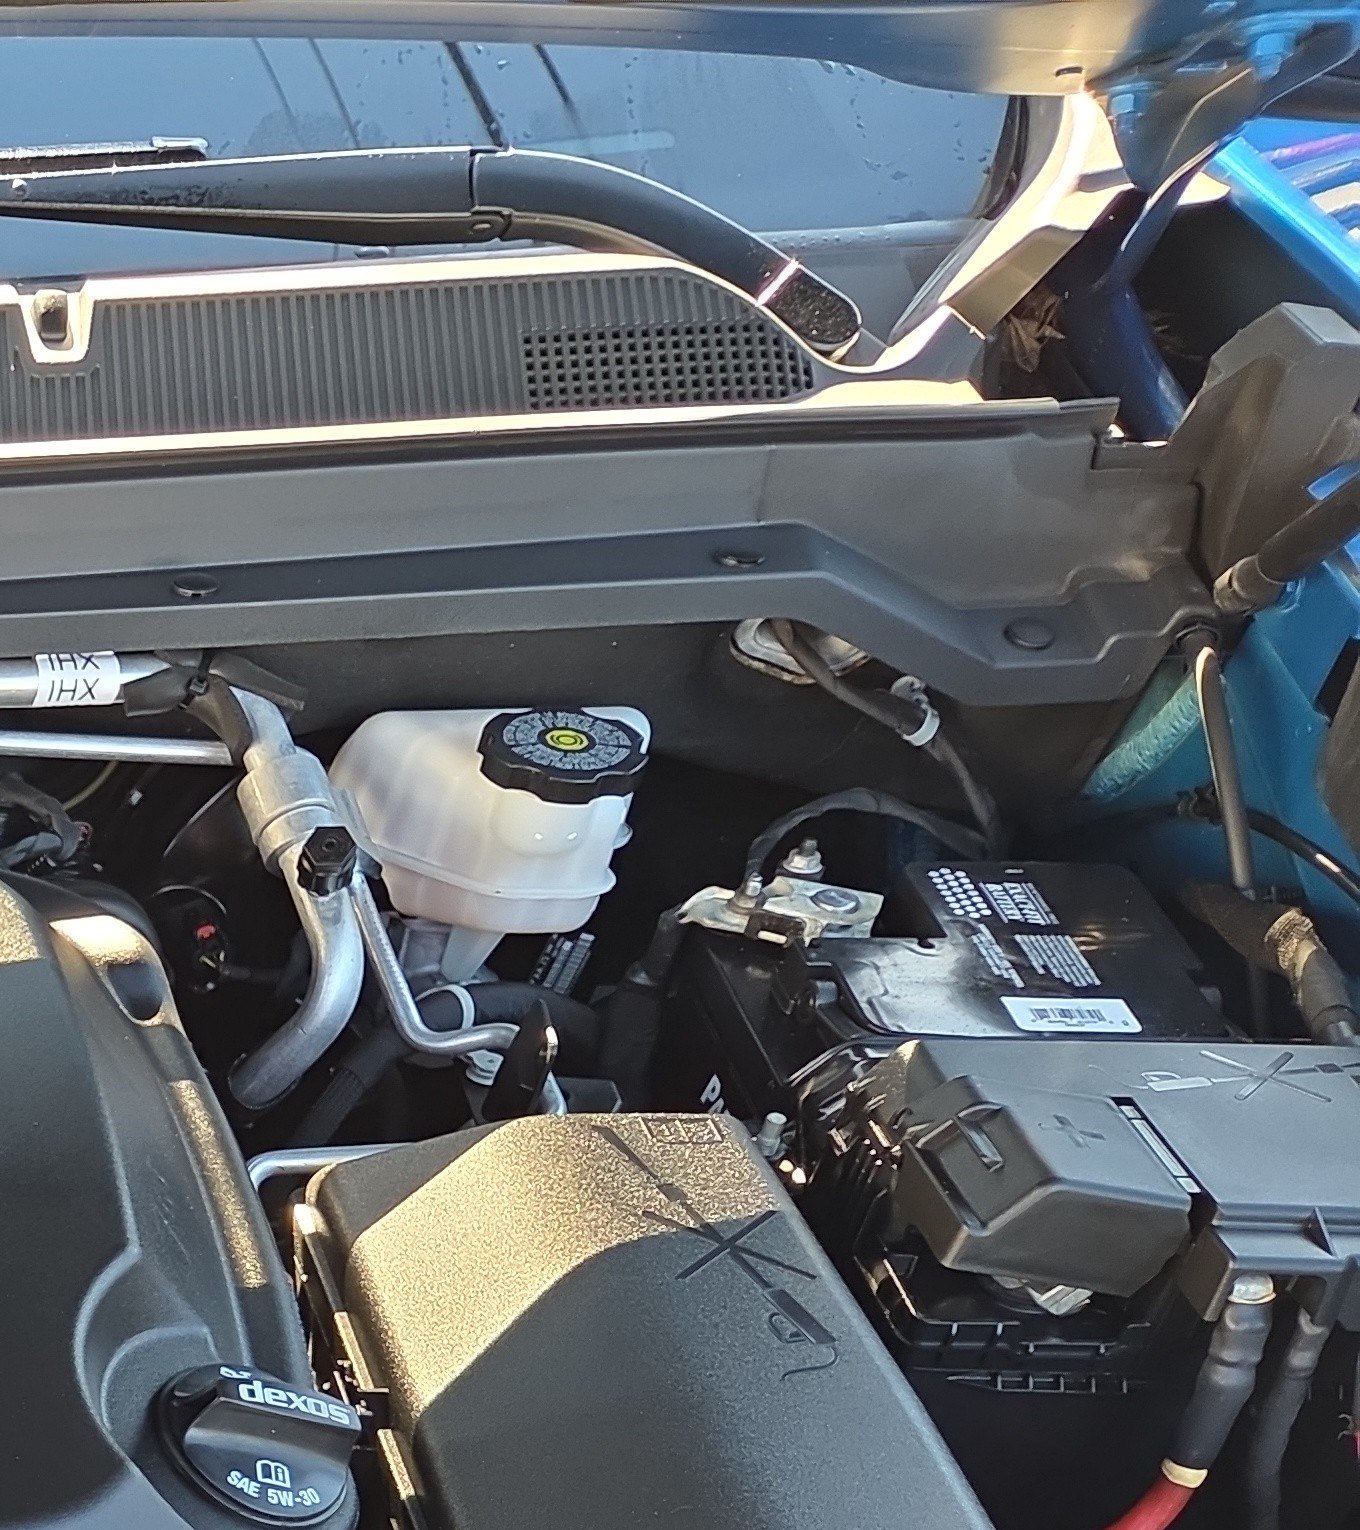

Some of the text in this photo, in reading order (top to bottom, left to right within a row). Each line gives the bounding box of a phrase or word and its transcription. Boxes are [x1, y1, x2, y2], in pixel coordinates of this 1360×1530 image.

[237, 1379, 350, 1426] dexos
[226, 1470, 321, 1508] SAE 5W-30
